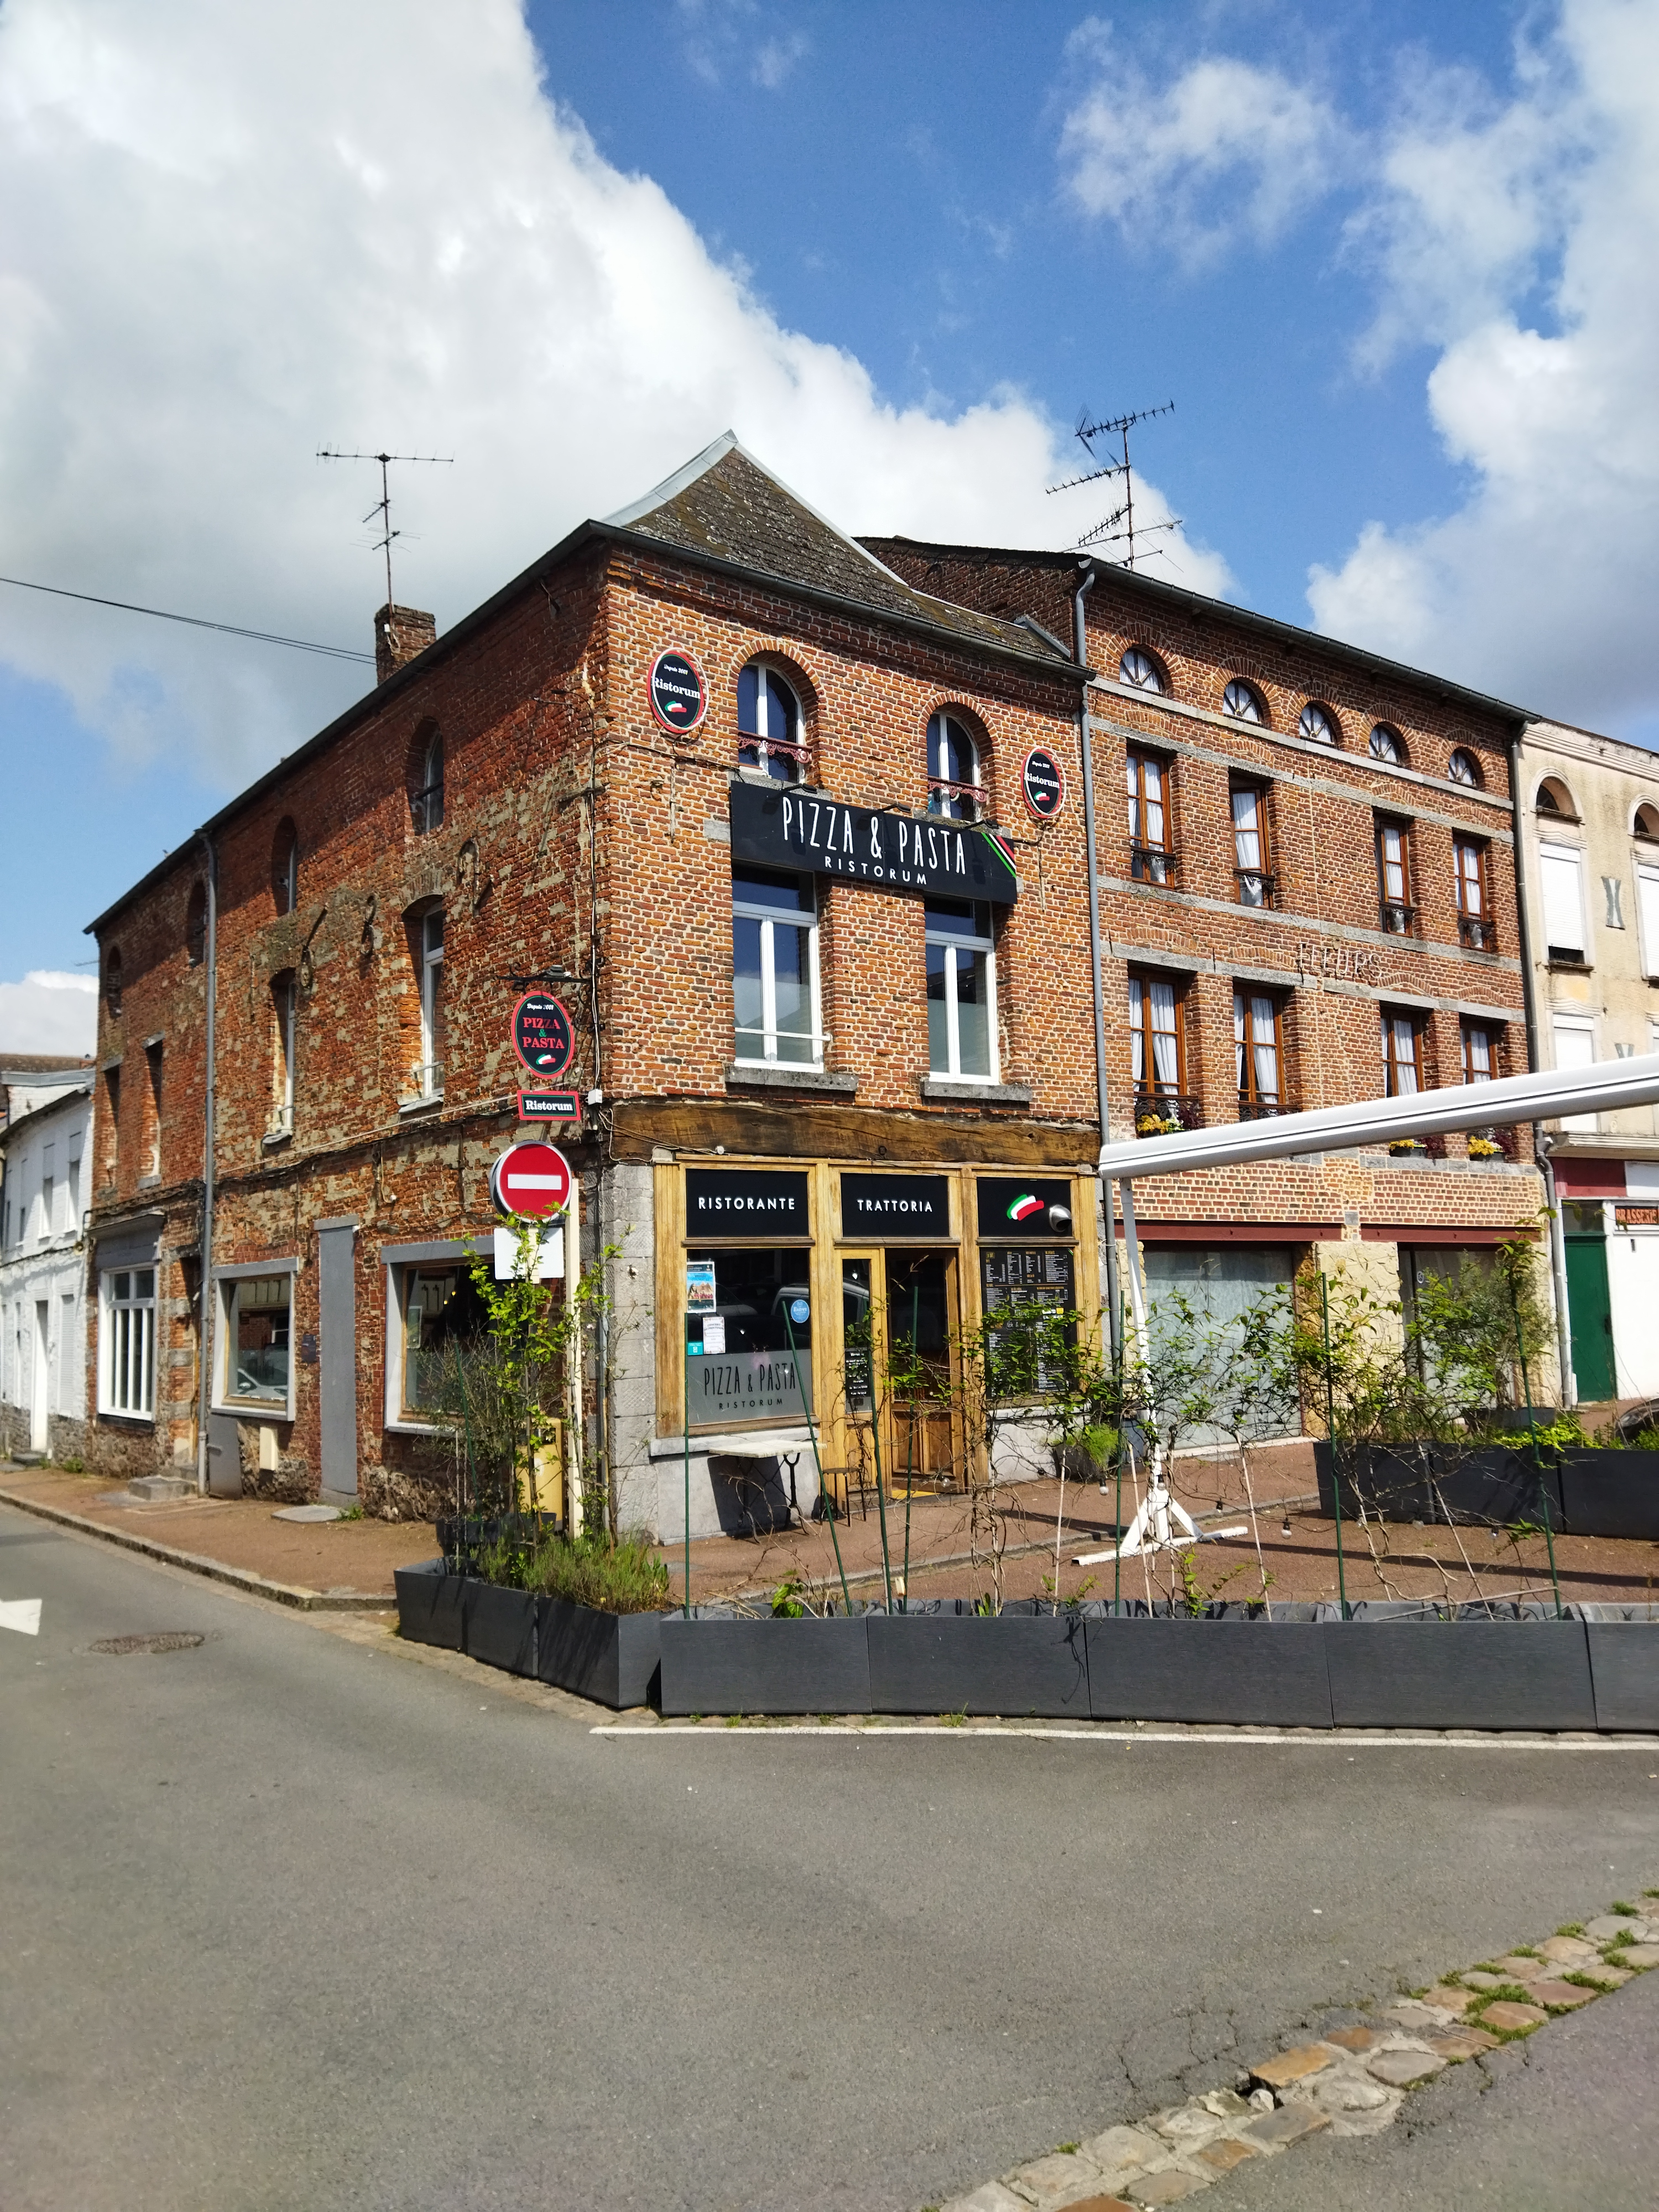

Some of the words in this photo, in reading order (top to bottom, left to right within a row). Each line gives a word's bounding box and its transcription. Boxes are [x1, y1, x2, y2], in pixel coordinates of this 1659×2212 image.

[651, 676, 701, 700] Ristorum
[1024, 773, 1060, 789] Ristorum
[782, 796, 853, 854] PIZZA
[870, 817, 882, 859] &
[899, 821, 966, 874] PASTA
[825, 855, 927, 885] RISTORUM
[1297, 942, 1382, 979] FLEURS
[523, 1017, 561, 1030] PIZZA
[539, 1029, 547, 1037] &
[522, 1037, 565, 1049] PASTA
[525, 1100, 573, 1111] Ristorum
[698, 1197, 795, 1210] RISTORANTE
[857, 1199, 933, 1212] TRATTORIA
[704, 1366, 740, 1396] PIZZA
[748, 1374, 753, 1392] &
[759, 1362, 796, 1391] PASTA
[719, 1398, 782, 1410] RISTORUM
